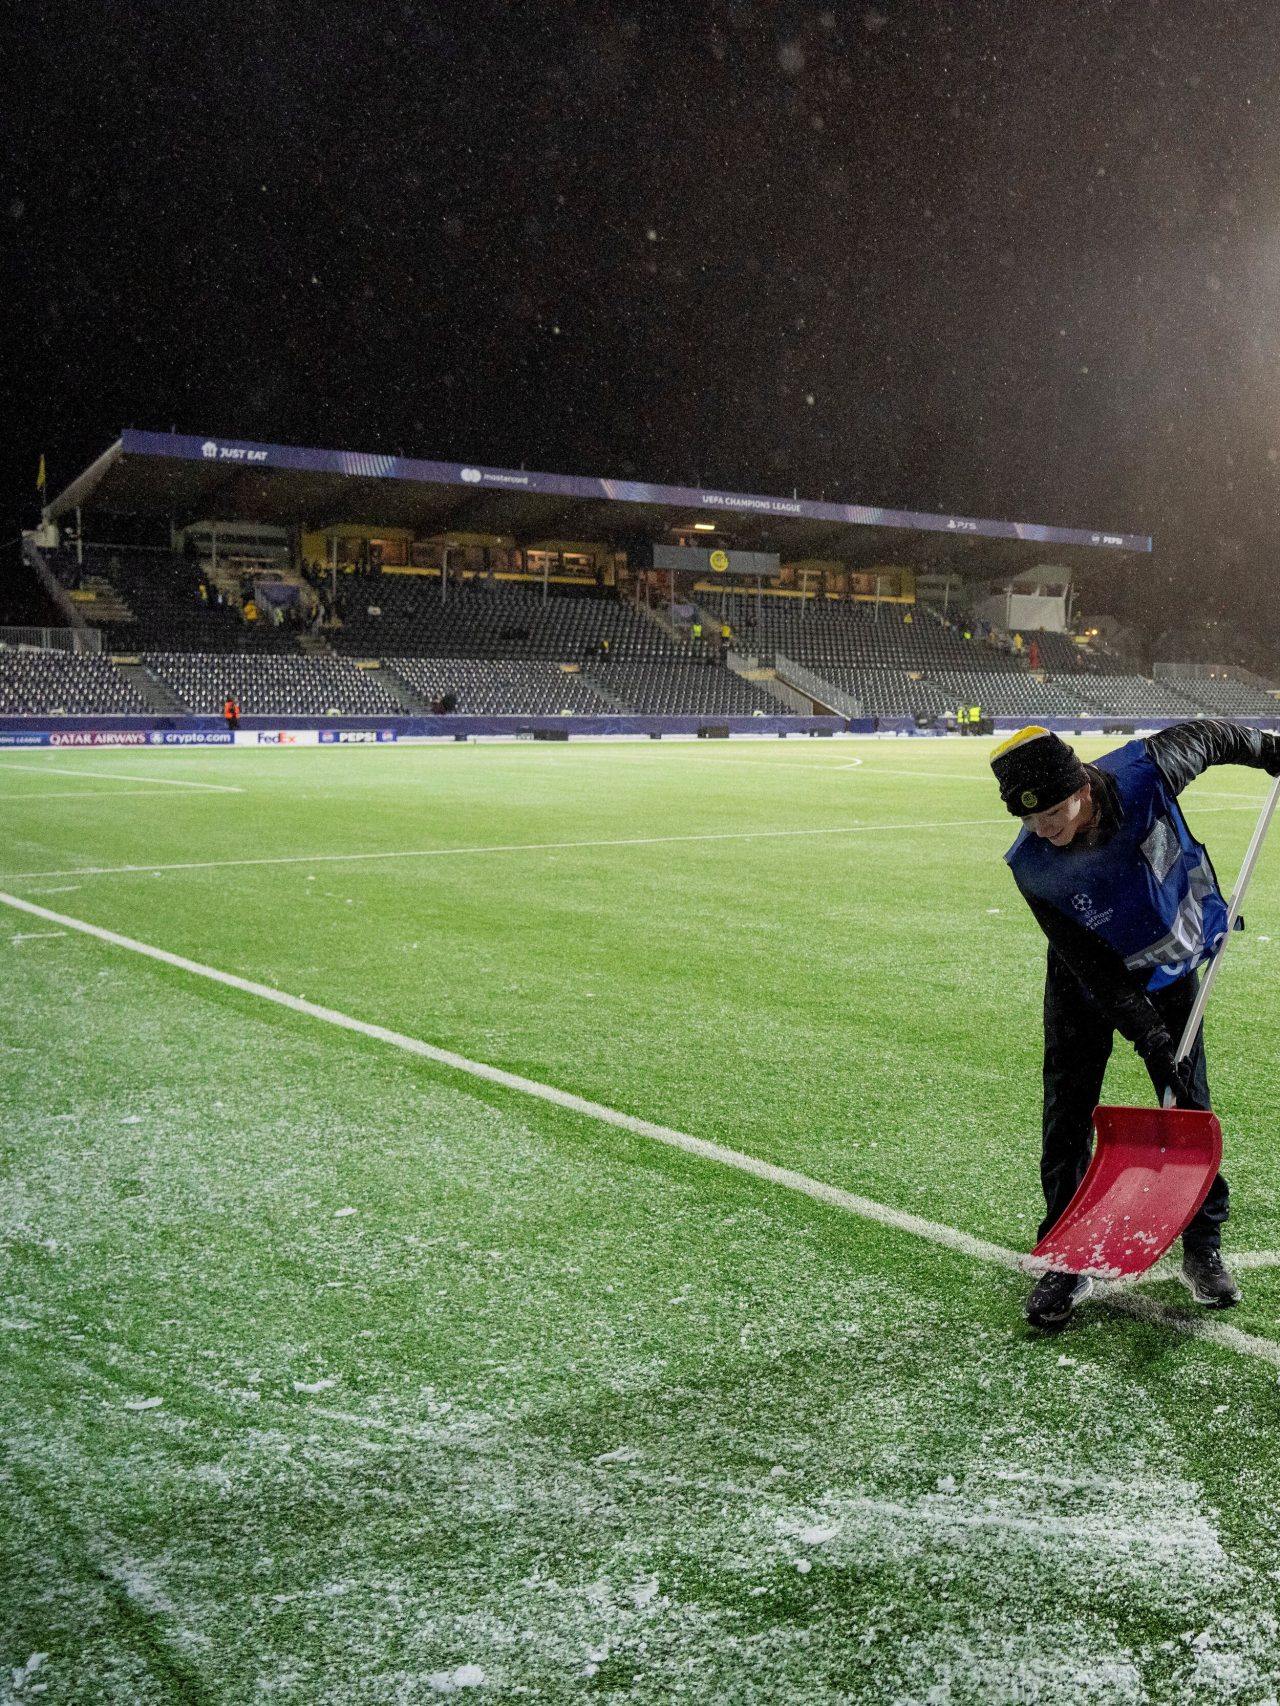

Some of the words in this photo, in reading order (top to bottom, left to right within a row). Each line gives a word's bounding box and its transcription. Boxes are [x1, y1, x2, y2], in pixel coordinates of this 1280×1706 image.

[220, 447, 246, 459] JUST
[247, 450, 268, 461] EAT
[484, 473, 528, 484] mastercard
[702, 495, 724, 504] UEFA
[725, 497, 770, 509] CHAMPIONS
[772, 502, 800, 512] LEAGUE
[957, 522, 977, 530] PS5
[1103, 536, 1123, 545] PEPSI
[50, 734, 92, 745] QATAR
[93, 733, 146, 745] AIRWAYS
[166, 732, 231, 744] crypto.com
[258, 732, 296, 743] FedEx
[340, 732, 377, 743] PEPSI
